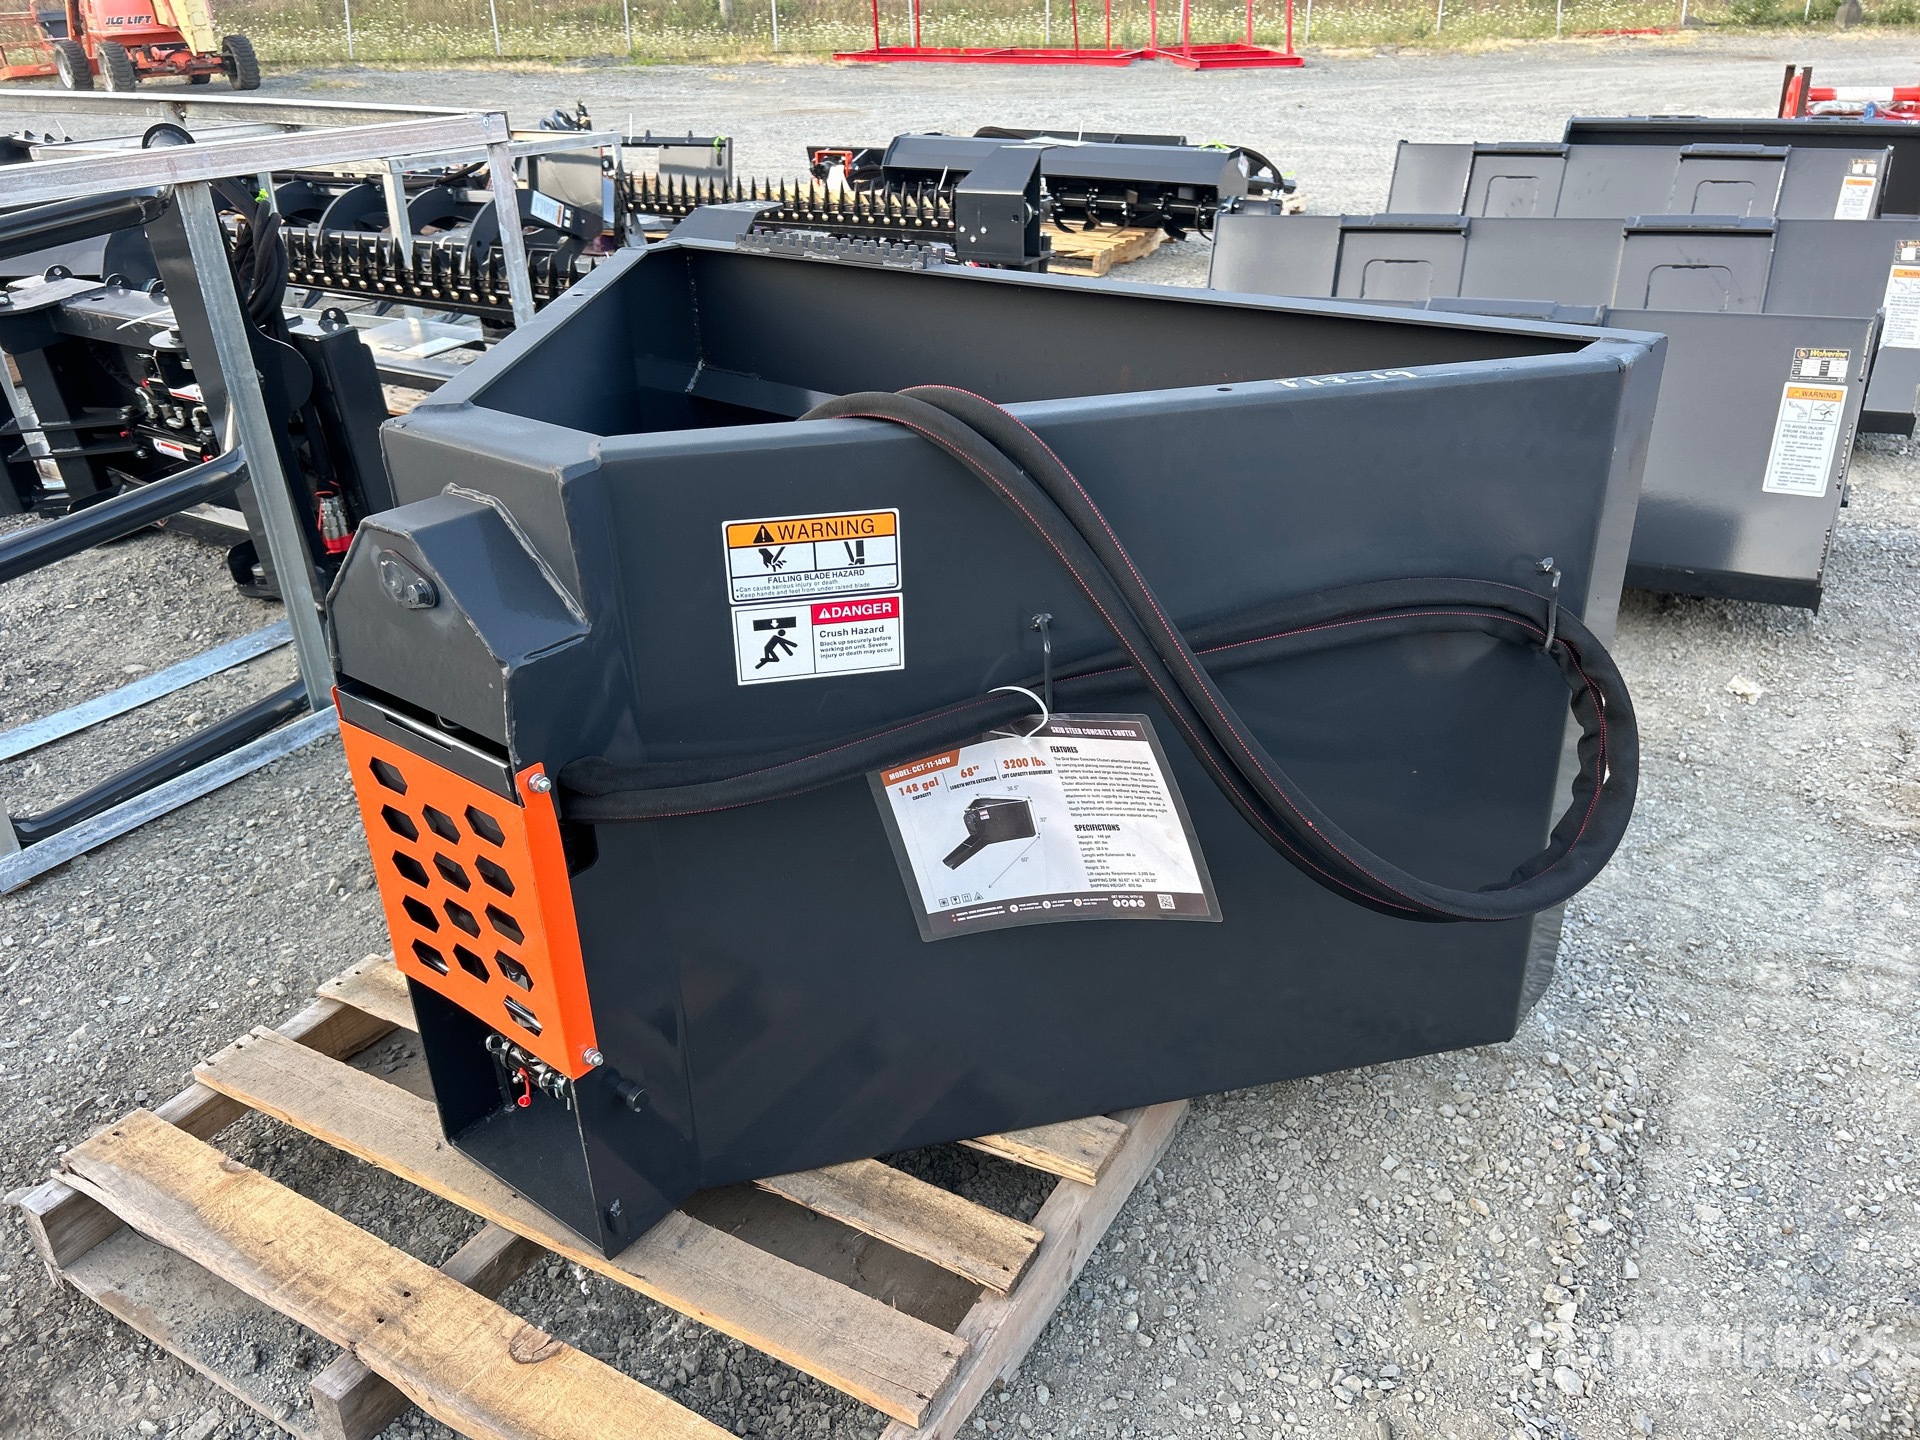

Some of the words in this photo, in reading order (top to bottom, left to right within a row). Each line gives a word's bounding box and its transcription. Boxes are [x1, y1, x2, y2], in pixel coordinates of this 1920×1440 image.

[127, 16, 152, 24] LIFT
[1810, 350, 1847, 358] Wolverine
[1802, 390, 1837, 399] WARNING
[777, 518, 875, 540] WARNING
[768, 574, 802, 584] FALLING
[804, 572, 830, 581] BLADE
[832, 569, 865, 578] HAZARD
[832, 603, 892, 618] DANGER
[820, 629, 848, 638] Crush
[851, 625, 884, 635] Hazard
[889, 769, 912, 780] MODEL:
[912, 756, 950, 773] CCT-11-148V
[1003, 758, 1029, 769] 3200
[1031, 757, 1046, 766] lbs
[960, 765, 979, 778] 68"
[898, 783, 919, 796] 148
[922, 776, 939, 791] gal
[912, 792, 932, 800] CAPACITY
